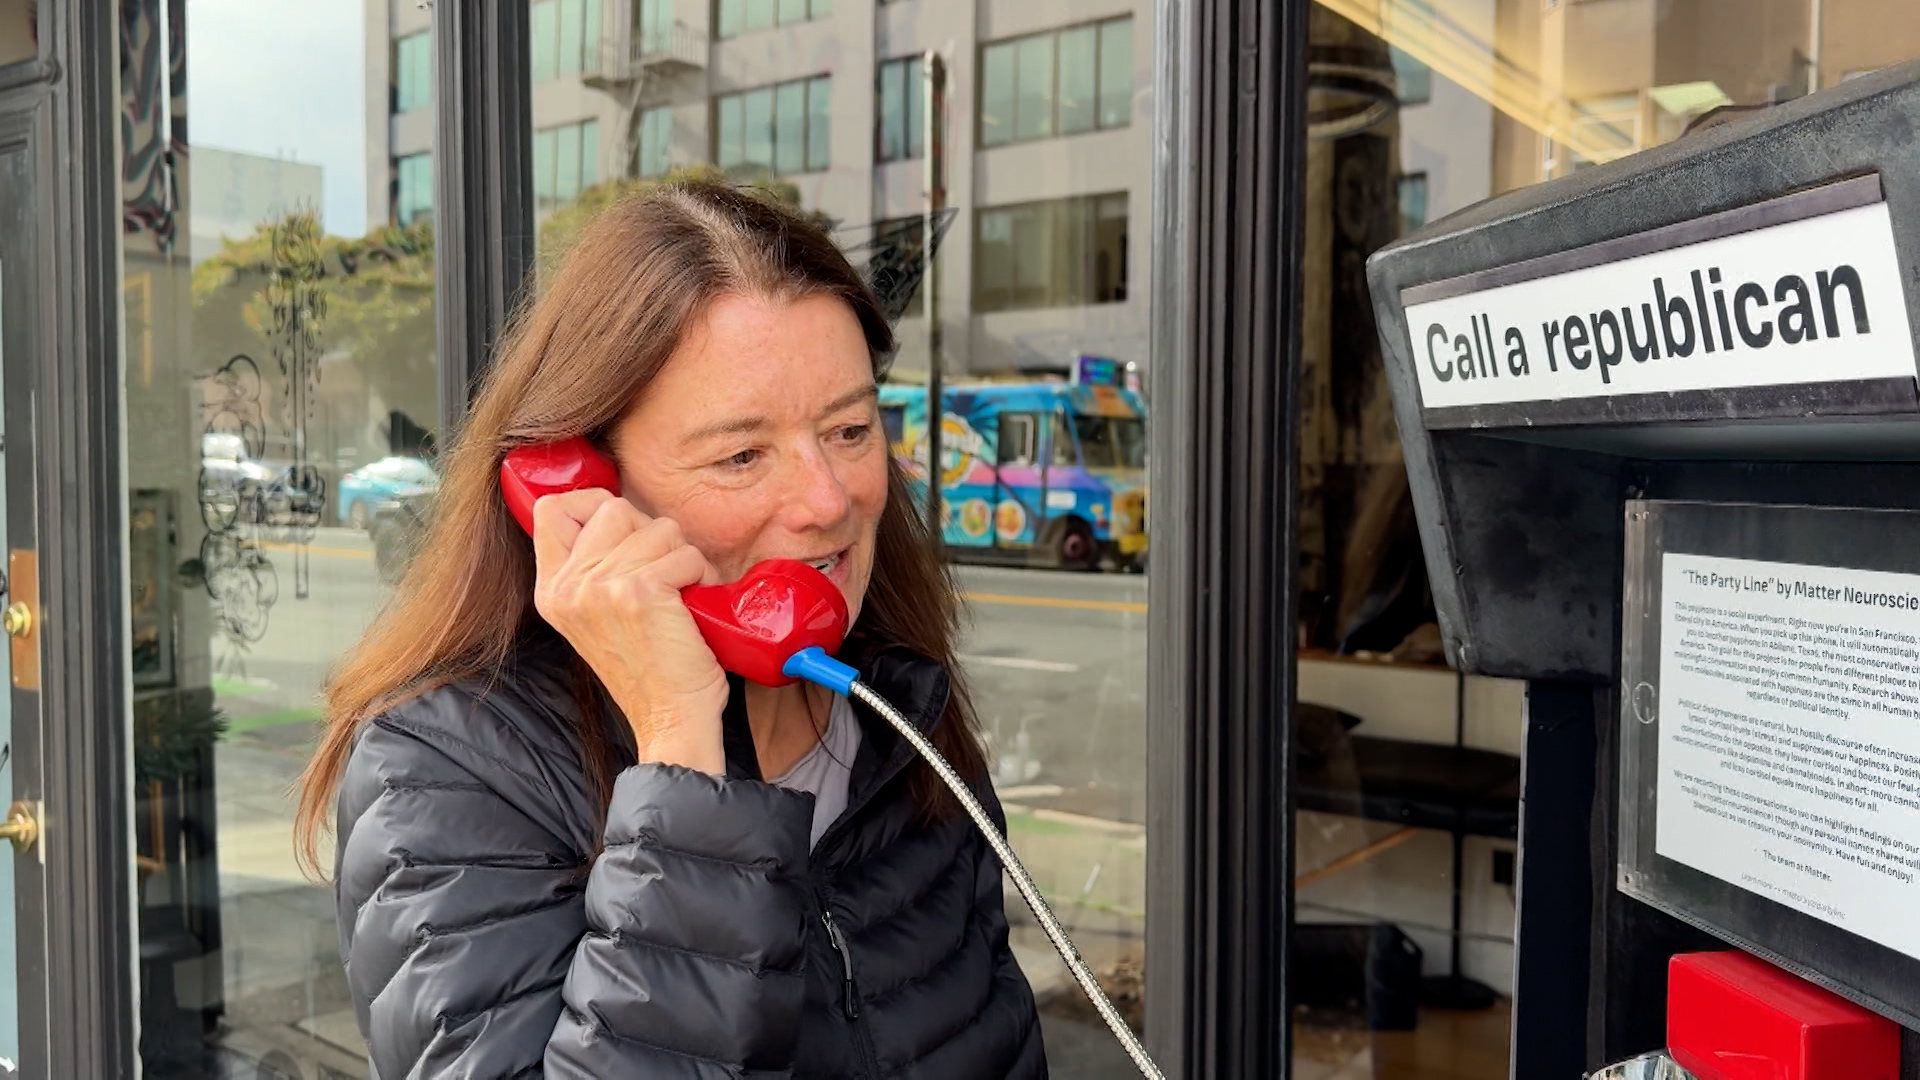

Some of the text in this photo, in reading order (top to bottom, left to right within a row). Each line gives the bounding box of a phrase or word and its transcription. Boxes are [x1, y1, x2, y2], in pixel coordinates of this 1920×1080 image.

[1426, 264, 1872, 384] Call a republican
[1710, 572, 1741, 594] Party
[1777, 579, 1792, 600] by
[1794, 580, 1841, 601] Matter
[1844, 586, 1919, 611] Neuroscie
[1693, 617, 1705, 627] city
[1705, 618, 1711, 626] in
[1740, 623, 1759, 634] When
[1760, 628, 1772, 637] you
[1773, 629, 1787, 639] pick
[1789, 633, 1798, 642] up
[1799, 632, 1812, 642] this
[1840, 638, 1845, 648] it
[1847, 640, 1861, 650] will
[1863, 643, 1919, 662] automatically
[1717, 606, 1722, 615] is
[1728, 609, 1746, 619] social
[1788, 617, 1807, 629] Right
[1808, 622, 1824, 630] now
[1850, 626, 1857, 635] in
[1858, 627, 1873, 638] San
[1876, 629, 1918, 647] Francisco,
[1697, 630, 1705, 638] to
[1729, 637, 1761, 648] payphone
[1762, 640, 1768, 649] in
[1822, 650, 1834, 660] the
[1835, 654, 1856, 664] most
[1857, 657, 1910, 673] conservative
[1707, 643, 1917, 688] The goal for this project is for people from different places to
[1725, 674, 1760, 686] associated
[1761, 679, 1776, 690] with
[1777, 682, 1812, 697] happiness
[1814, 691, 1825, 700] are
[1827, 691, 1840, 703] the
[1841, 696, 1862, 708] same
[1863, 698, 1870, 709] in
[1872, 701, 1881, 712] all
[1883, 702, 1912, 718] human
[1747, 691, 1850, 721] regardless of political identity.
[1748, 665, 1760, 673] and
[1761, 667, 1779, 680] enjoy
[1781, 671, 1811, 683] common
[1852, 682, 1889, 699] Research
[1890, 691, 1919, 705] shows
[1733, 723, 1751, 736] levels
[1778, 737, 1792, 746] and
[1792, 740, 1833, 757] suppresses
[1834, 751, 1847, 761] our
[1849, 753, 1892, 772] happiness.
[1749, 716, 1759, 725] are
[1786, 723, 1798, 735] but
[1800, 726, 1825, 741] hostile
[1826, 733, 1863, 751] discourse
[1864, 743, 1886, 756] often
[1727, 748, 1738, 759] like
[1772, 762, 1785, 772] and
[1837, 778, 1845, 788] In
[1871, 790, 1892, 802] more
[1732, 737, 1742, 747] the
[1775, 747, 1789, 761] they
[1791, 751, 1811, 765] lower
[1813, 759, 1841, 773] cortisol
[1843, 767, 1857, 778] and
[1858, 768, 1881, 784] boost
[1882, 777, 1897, 788] our
[1720, 761, 1879, 813] and less cortisol equals more happiness for all.
[1693, 777, 1722, 794] recording
[1723, 784, 1740, 797] these
[1741, 792, 1788, 812] conversations
[1789, 807, 1797, 815] so
[1798, 810, 1809, 819] we
[1810, 814, 1823, 824] can
[1824, 816, 1858, 835] highlight
[1859, 827, 1891, 847] findings
[1893, 839, 1903, 849] on
[1905, 843, 1919, 855] our
[1728, 813, 1736, 822] as
[1737, 817, 1746, 825] we
[1747, 818, 1776, 836] treasure
[1777, 830, 1792, 841] your
[1836, 848, 1855, 863] Have
[1857, 855, 1869, 868] fun
[1871, 862, 1886, 874] and
[1775, 814, 1799, 830] though
[1801, 824, 1813, 836] any
[1814, 829, 1847, 846] personal
[1848, 840, 1874, 856] names
[1876, 848, 1904, 866] shared
[1763, 849, 1832, 883] The team at Matter.
